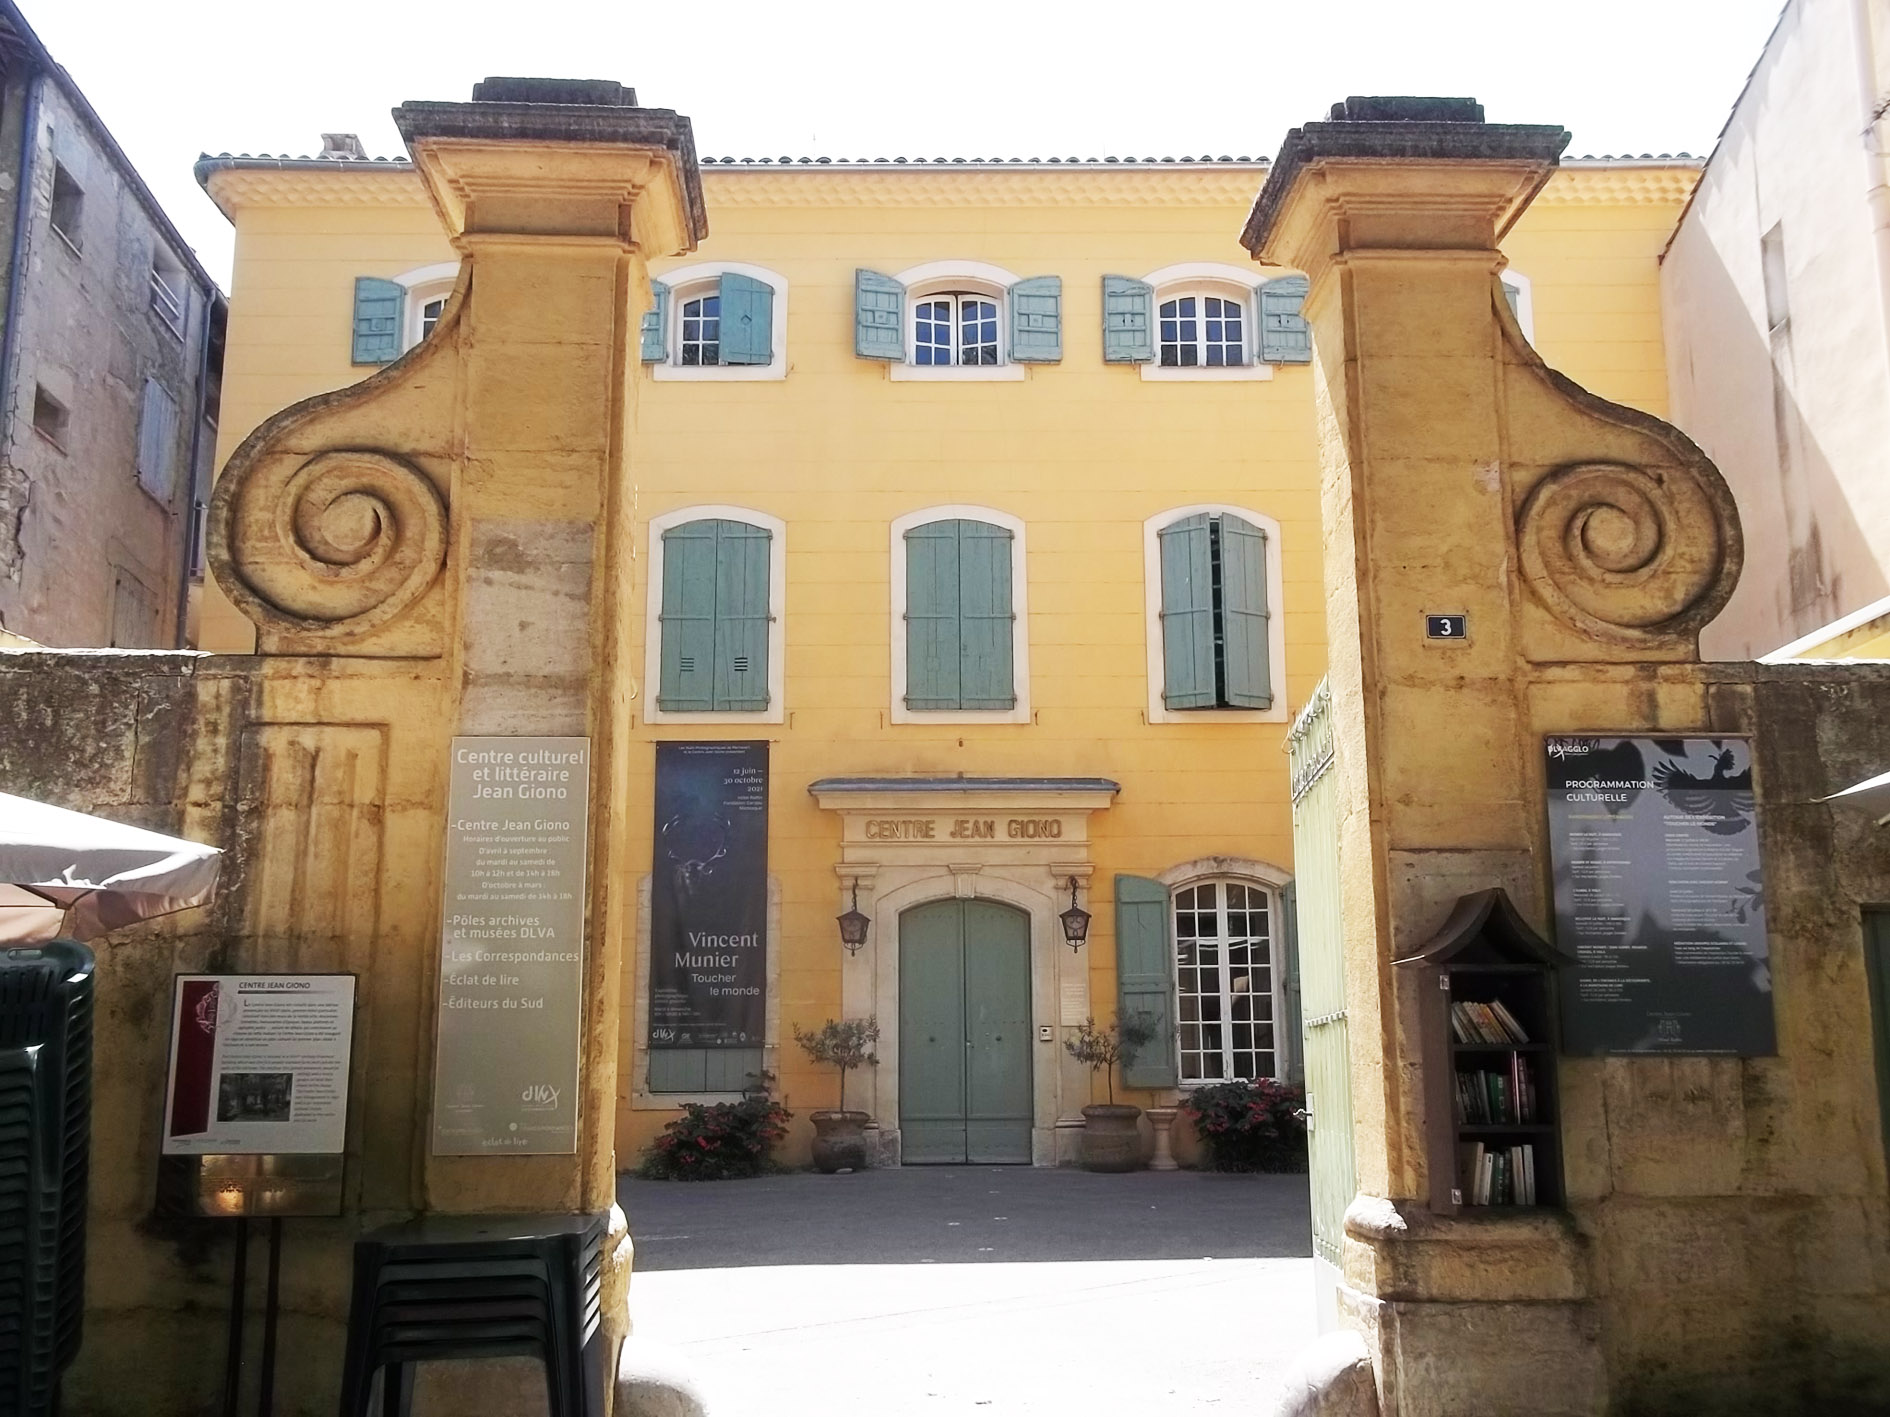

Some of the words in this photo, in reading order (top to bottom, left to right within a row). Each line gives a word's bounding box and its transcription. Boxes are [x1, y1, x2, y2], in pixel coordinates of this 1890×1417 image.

[1440, 618, 1452, 636] 3
[457, 749, 514, 764] Centre
[518, 749, 584, 764] culturel
[473, 767, 490, 781] et
[496, 766, 570, 782] littéraire
[740, 767, 756, 776] juin
[734, 776, 763, 784] octobre
[1565, 780, 1654, 788] PROGRAMMATION
[472, 784, 512, 799] Jean
[518, 784, 567, 799] Giono
[1566, 794, 1628, 802] CULTURELLE
[502, 819, 531, 831] Jean
[534, 819, 570, 831] Giono
[866, 820, 936, 839] CENTRE
[950, 820, 995, 839] JEAN
[1008, 819, 1062, 838] GIONO
[489, 915, 540, 926] archives
[454, 928, 466, 938] et
[470, 928, 517, 938] musées
[520, 928, 555, 938] DLVA
[689, 932, 758, 948] Vincent
[476, 950, 579, 964] Correspondances
[675, 952, 738, 968] Munier
[482, 974, 496, 985] de
[500, 974, 519, 985] lire
[692, 973, 736, 982] Toucher
[710, 987, 719, 996] le
[722, 986, 760, 996] monde
[502, 998, 517, 1008] du
[520, 998, 544, 1008] Sud
